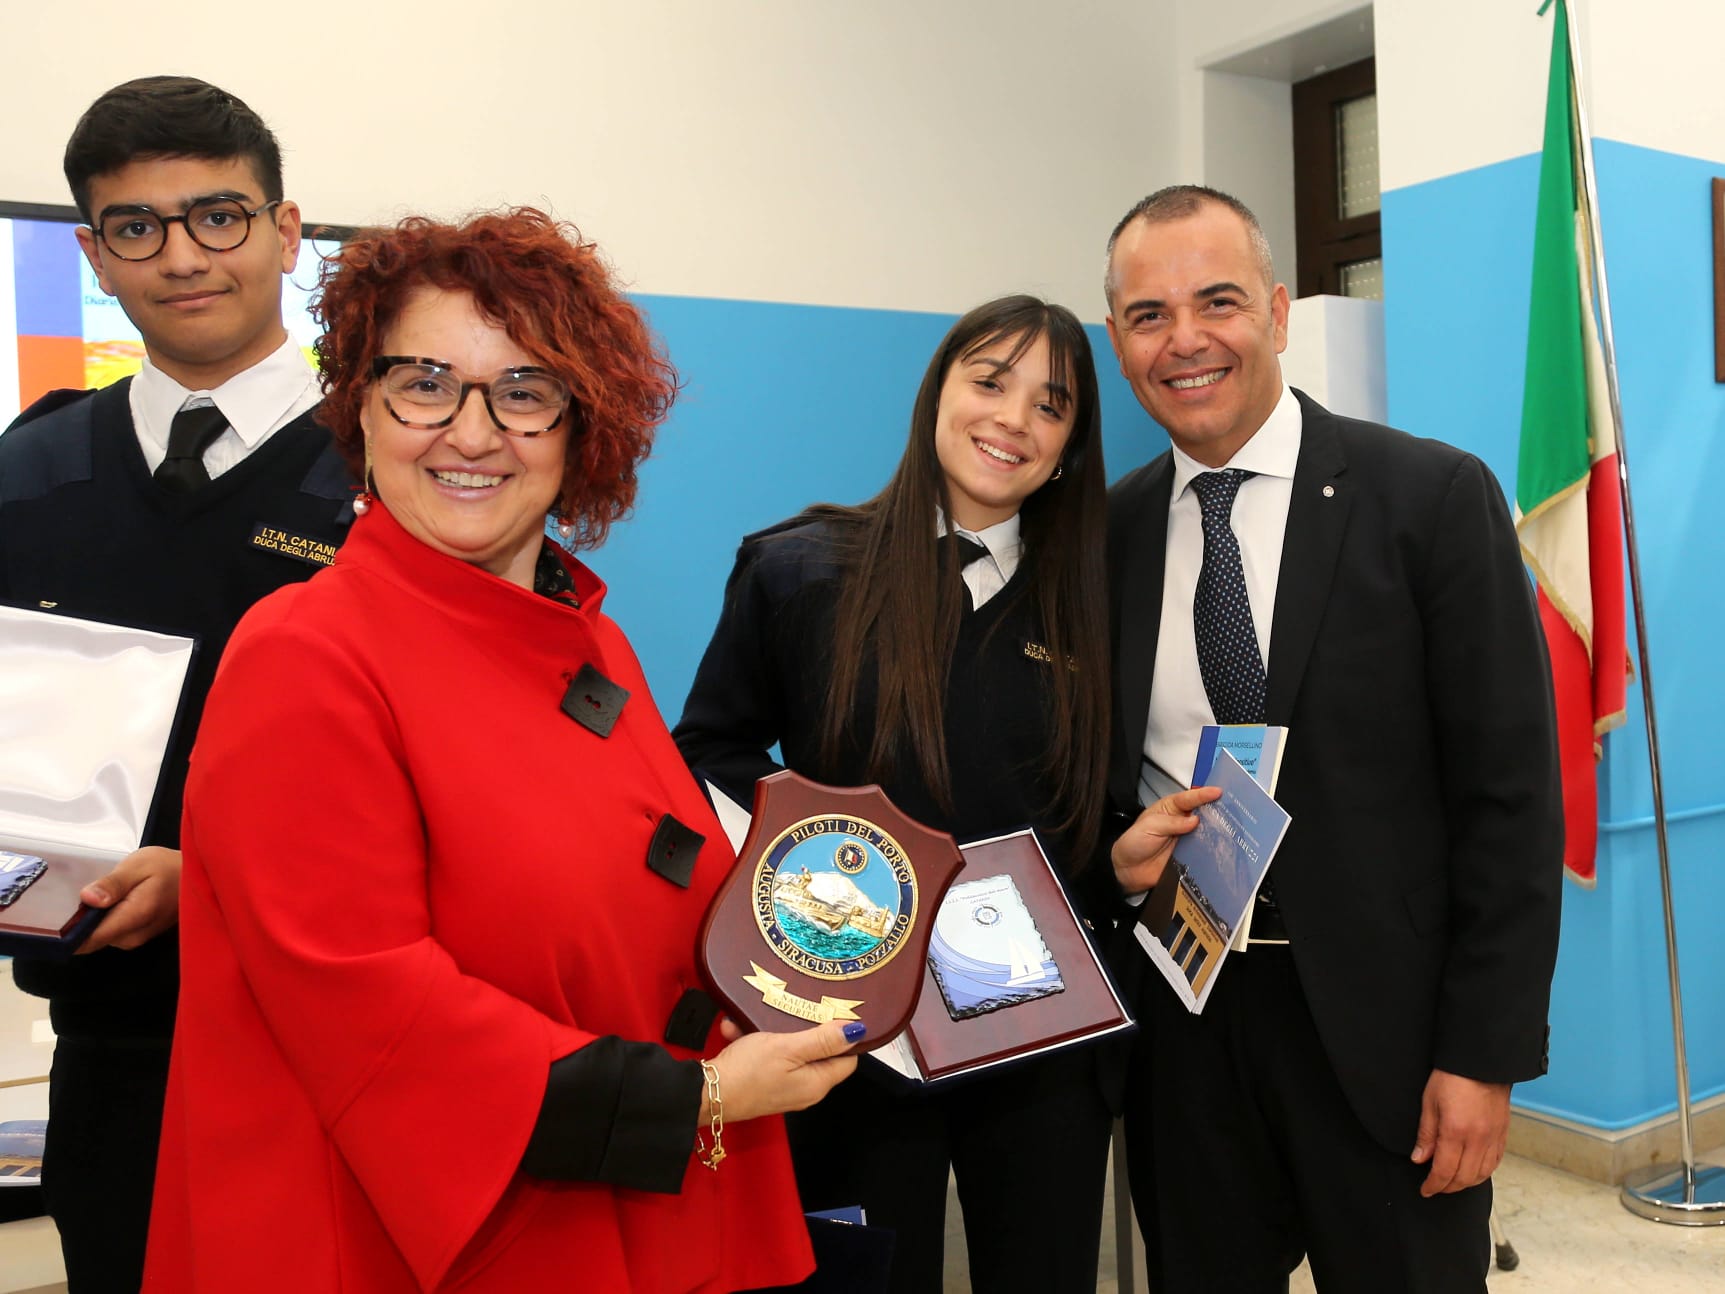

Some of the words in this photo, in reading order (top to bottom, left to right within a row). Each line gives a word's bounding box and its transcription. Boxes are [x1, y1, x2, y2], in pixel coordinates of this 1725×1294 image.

[253, 536, 279, 550] DUCA
[280, 543, 307, 558] DEGLI
[307, 551, 336, 566] ABRU
[290, 536, 336, 557] CATANI
[790, 819, 840, 843] PILOTI
[845, 821, 874, 842] DEL
[876, 838, 911, 883] PORTO
[758, 862, 776, 932] AUGUSTA
[778, 939, 844, 975] SIRACUSA
[857, 914, 910, 971] POZZALLO
